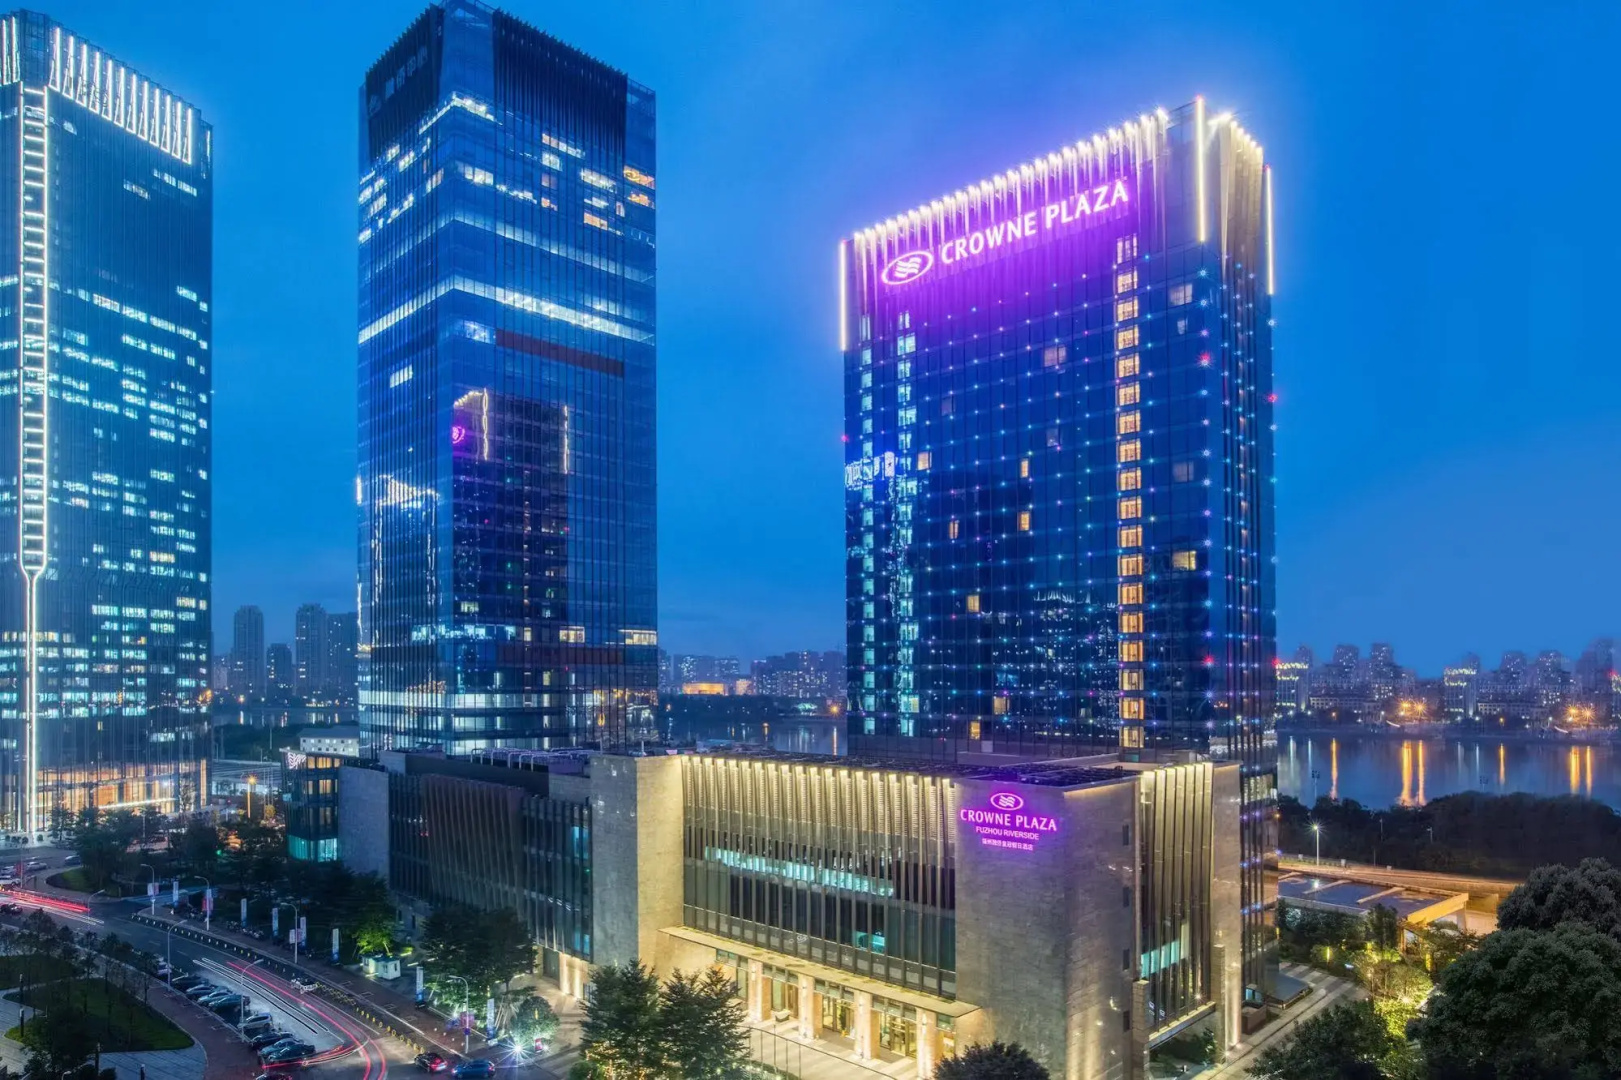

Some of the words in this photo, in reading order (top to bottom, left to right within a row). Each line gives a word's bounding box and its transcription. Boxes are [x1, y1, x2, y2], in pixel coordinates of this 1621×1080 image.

[941, 212, 1037, 263] CROWNE
[1045, 180, 1128, 229] PLAZA
[960, 809, 1011, 826] CROWNE
[1016, 815, 1057, 831] PLAZA
[976, 826, 1002, 836] FUZHOU
[1003, 830, 1039, 840] RIVERSIDE
